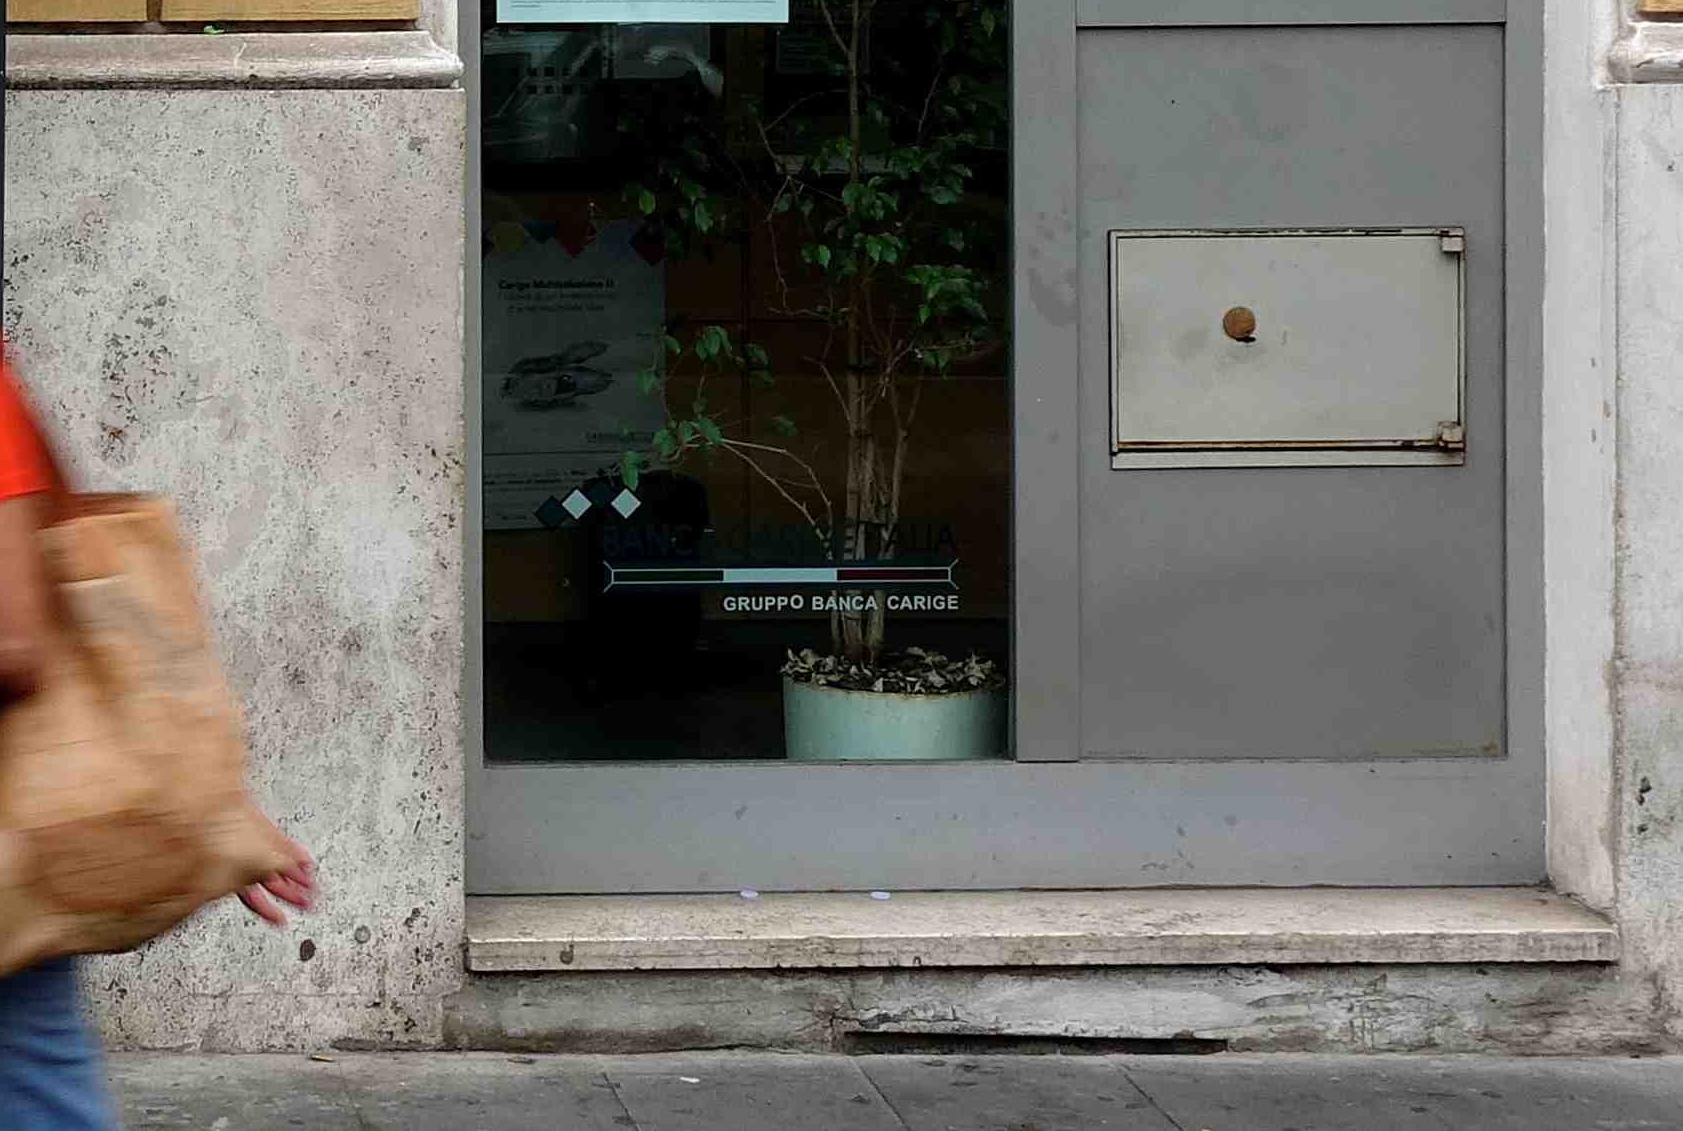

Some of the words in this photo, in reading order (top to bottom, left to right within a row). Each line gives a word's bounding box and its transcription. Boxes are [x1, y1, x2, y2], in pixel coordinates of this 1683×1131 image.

[723, 594, 804, 612] GRUPPO
[811, 594, 879, 611] BANCA
[886, 594, 959, 611] CARIGE
